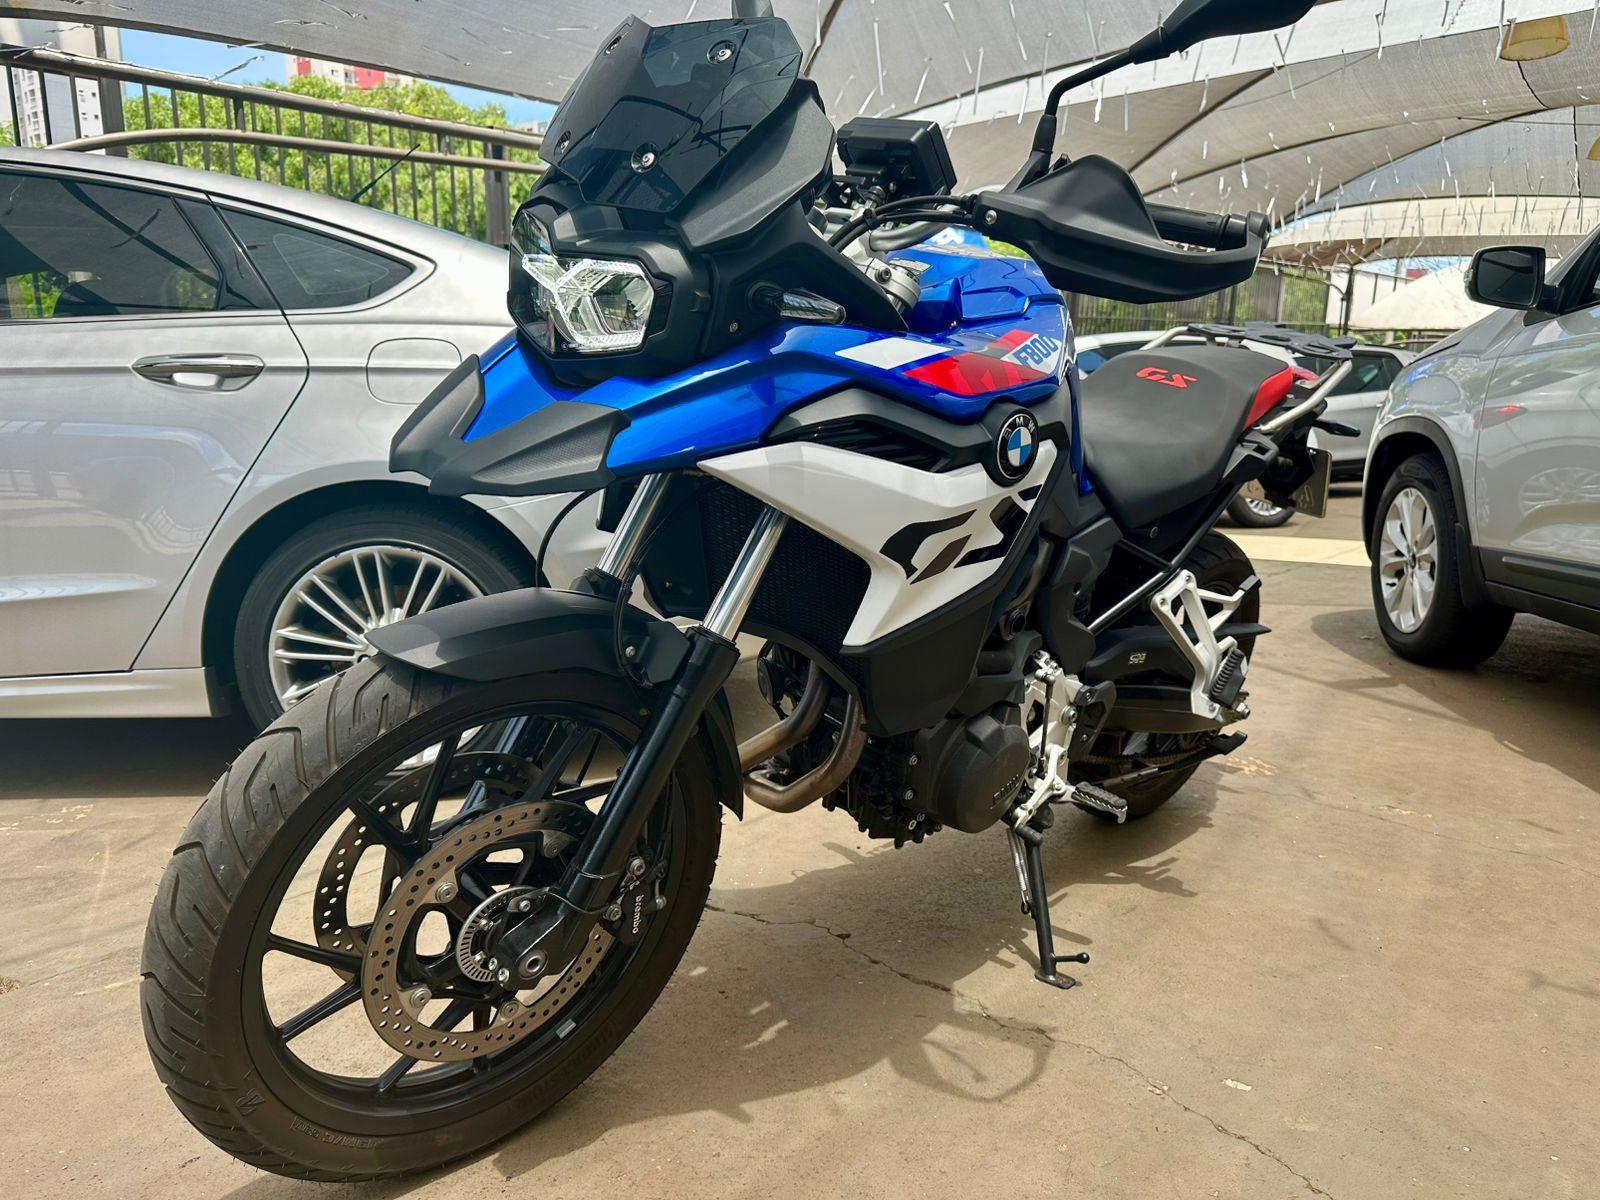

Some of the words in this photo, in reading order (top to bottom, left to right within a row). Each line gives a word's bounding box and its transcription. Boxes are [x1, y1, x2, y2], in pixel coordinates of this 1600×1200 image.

[1136, 367, 1198, 388] GS
[1002, 415, 1036, 440] BMW
[632, 894, 645, 934] brembo
